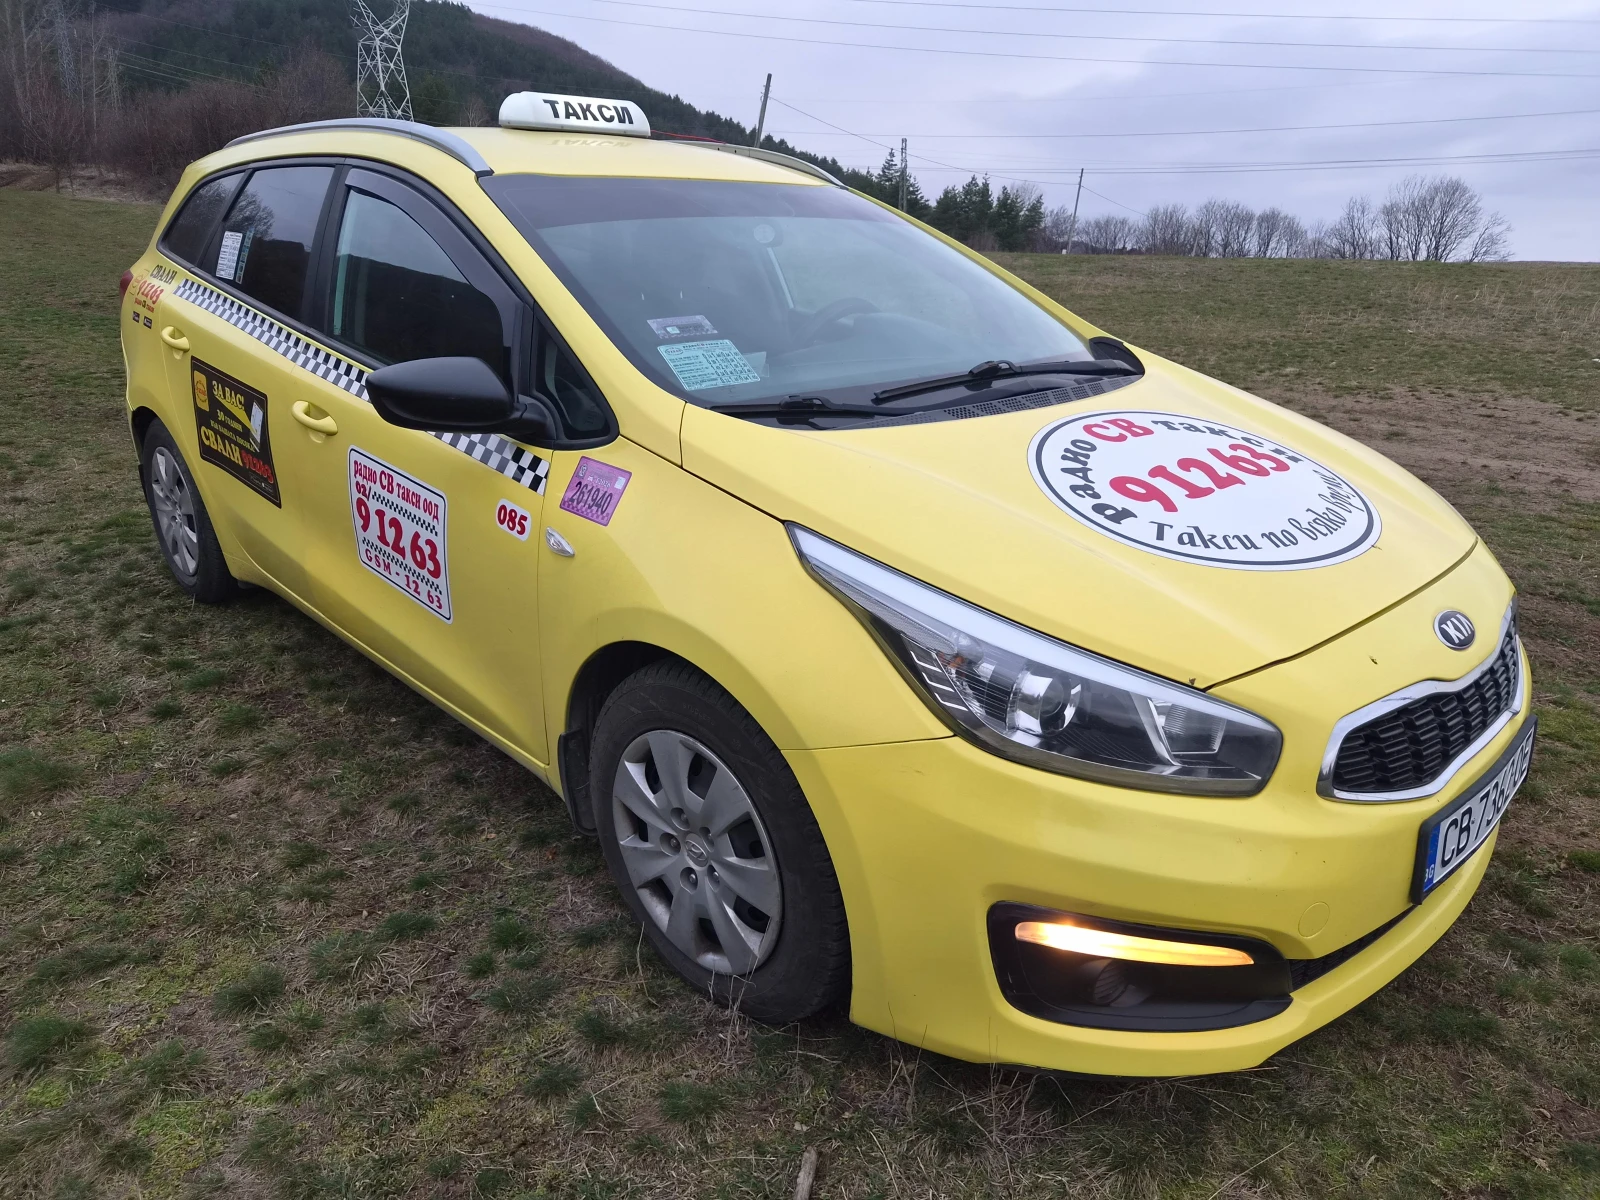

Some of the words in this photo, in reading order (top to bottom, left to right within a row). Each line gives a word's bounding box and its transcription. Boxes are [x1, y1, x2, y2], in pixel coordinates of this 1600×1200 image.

[542, 98, 634, 125] ТАКСИ
[212, 380, 224, 400] ЗА
[200, 425, 243, 467] СВАЛИ
[1082, 418, 1155, 443] СВ
[353, 460, 378, 485] радио
[379, 470, 395, 495] СВ
[395, 482, 422, 511] такси
[1109, 443, 1291, 513] 91263
[569, 481, 614, 516] 261940
[497, 504, 528, 536] 085
[1440, 613, 1475, 644] KIA
